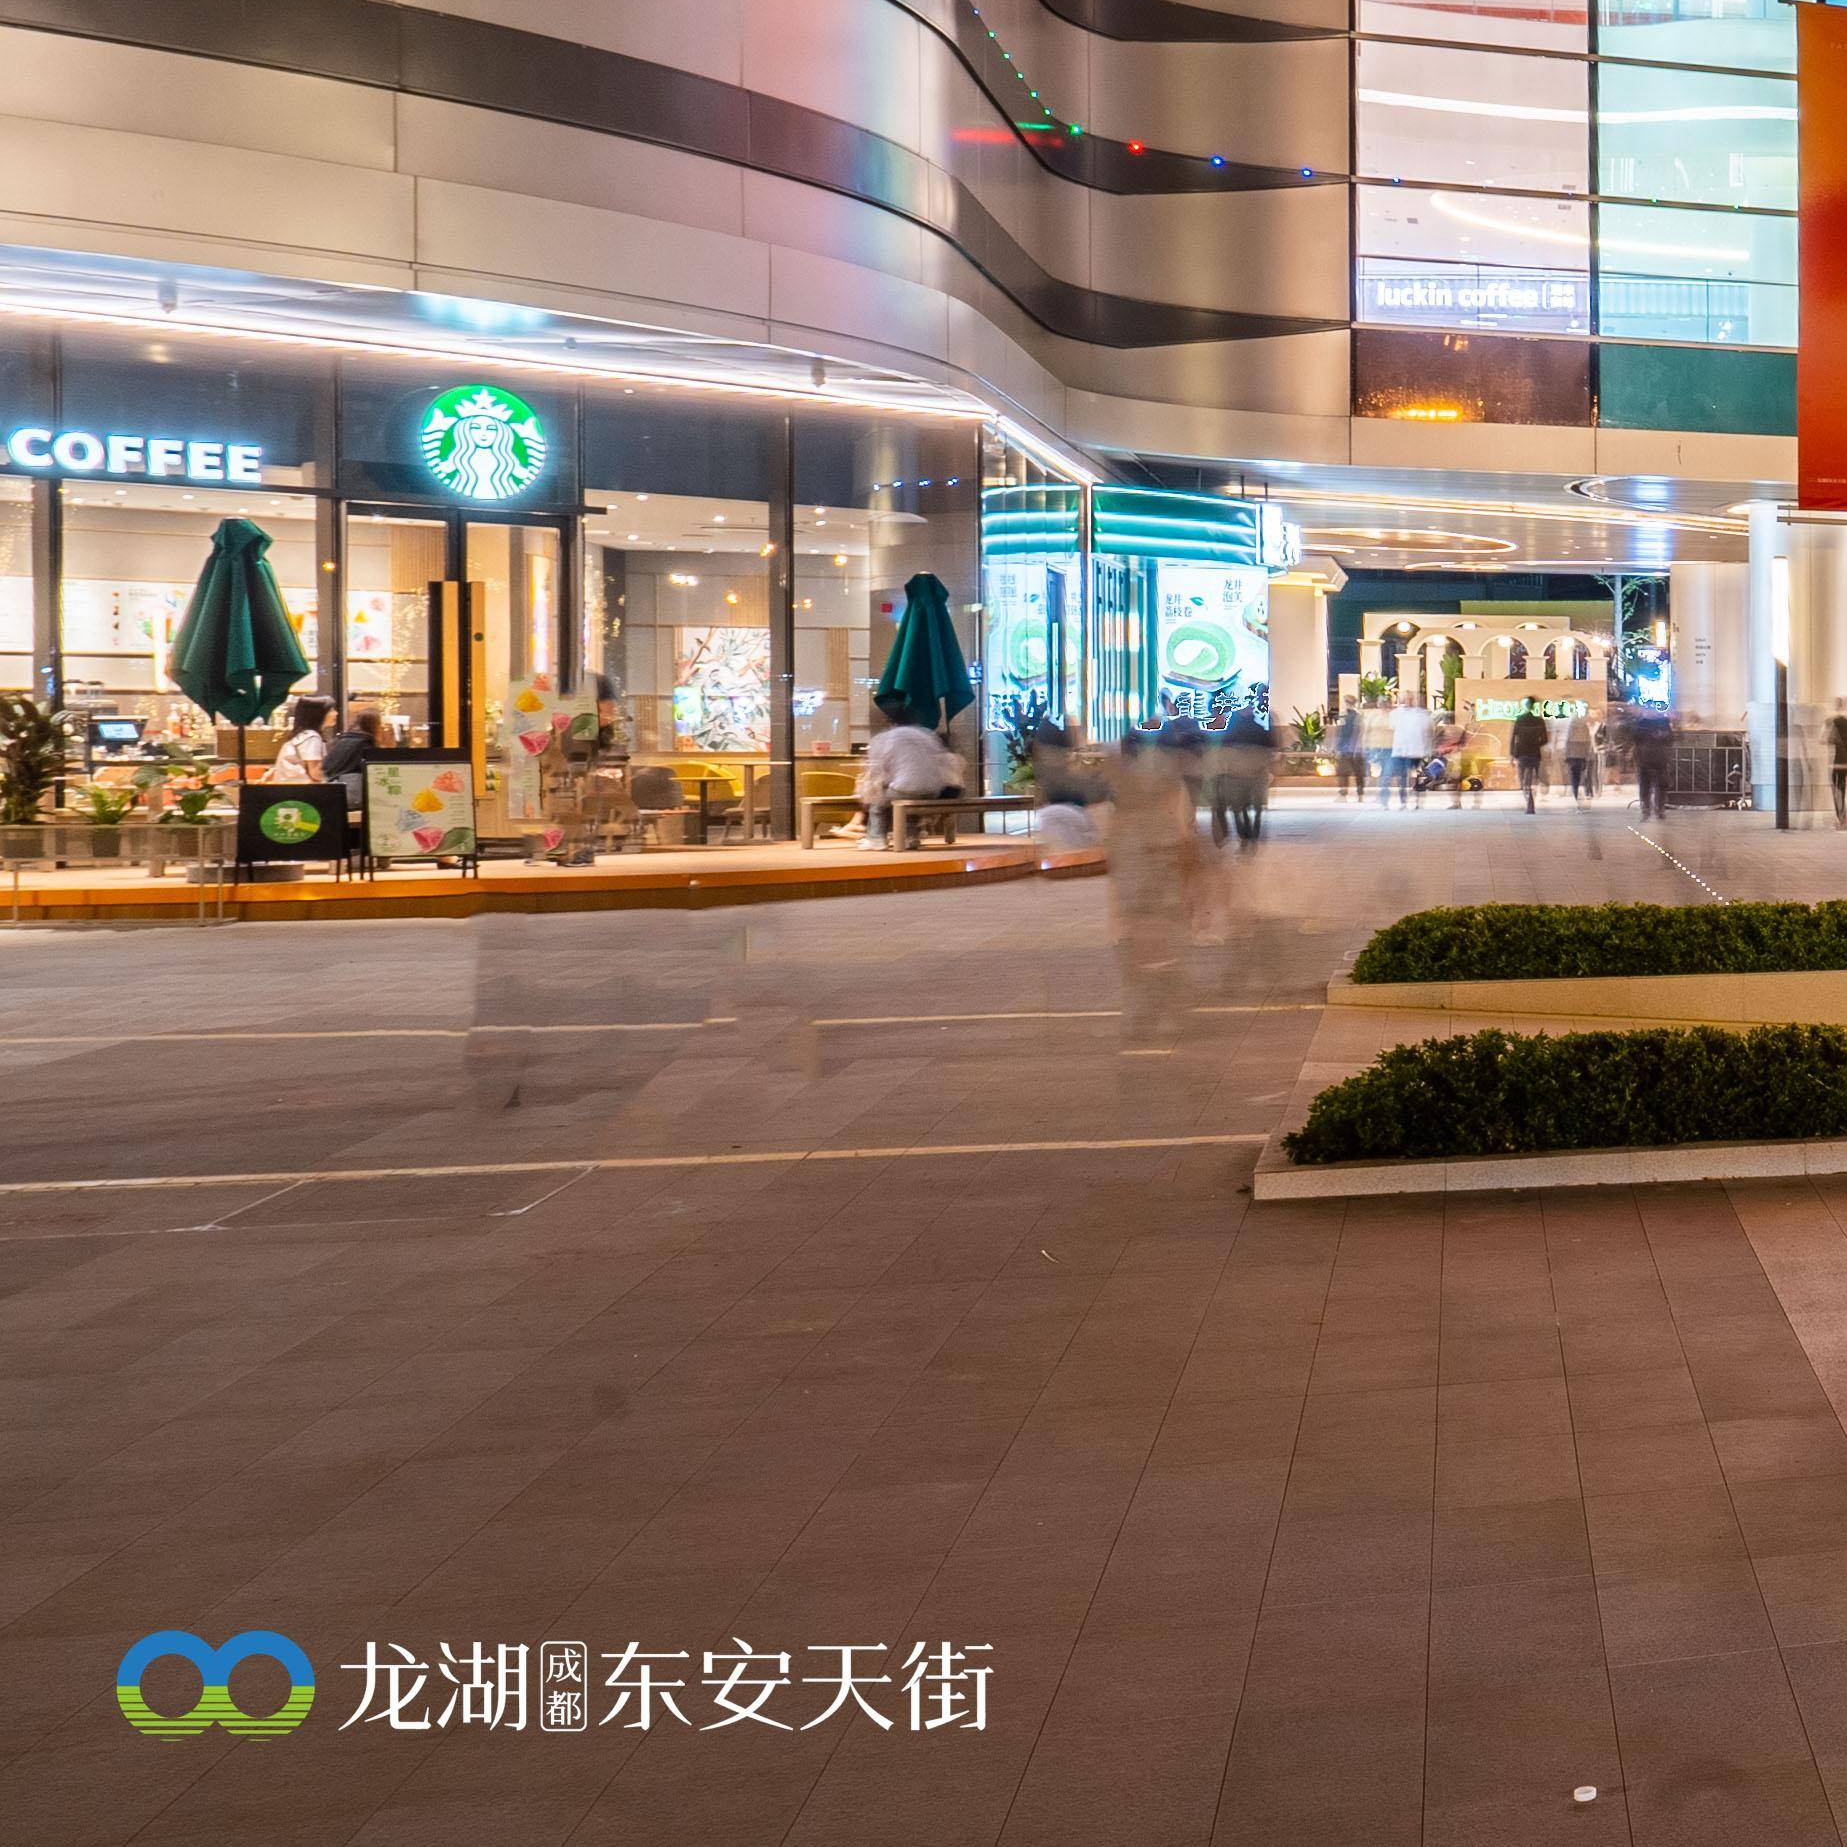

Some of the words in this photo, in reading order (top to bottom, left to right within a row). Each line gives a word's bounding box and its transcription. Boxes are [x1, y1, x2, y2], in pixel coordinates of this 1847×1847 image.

[1377, 280, 1453, 307] luckin
[1458, 282, 1540, 309] coffee
[7, 426, 263, 484] COFFEE
